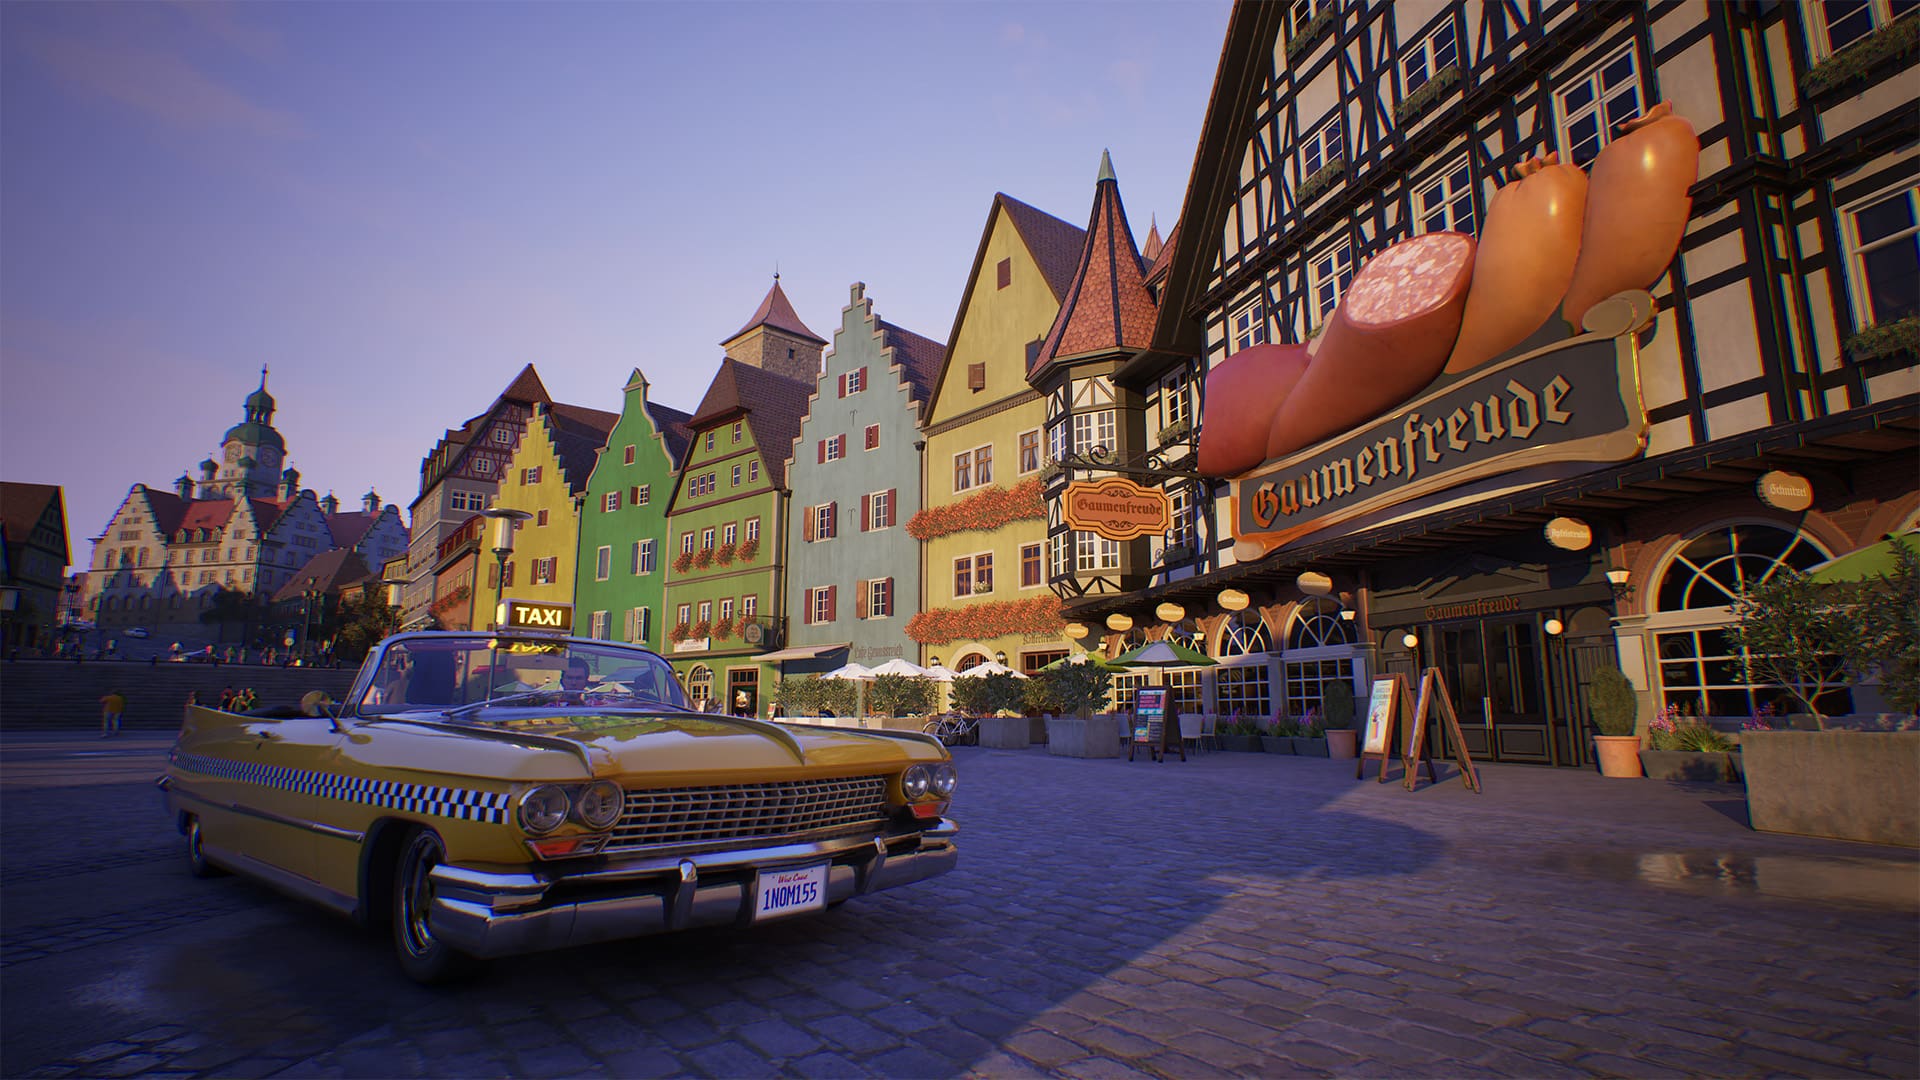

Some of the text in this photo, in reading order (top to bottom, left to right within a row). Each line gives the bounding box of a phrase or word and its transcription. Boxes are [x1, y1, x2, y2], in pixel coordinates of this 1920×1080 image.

[1251, 374, 1573, 528] Gaumenfreude
[1077, 498, 1161, 515] Gaumenfreude
[516, 606, 562, 626] TAXI
[1424, 596, 1520, 620] Gaumenfreude
[763, 881, 817, 910] 1NOM155
